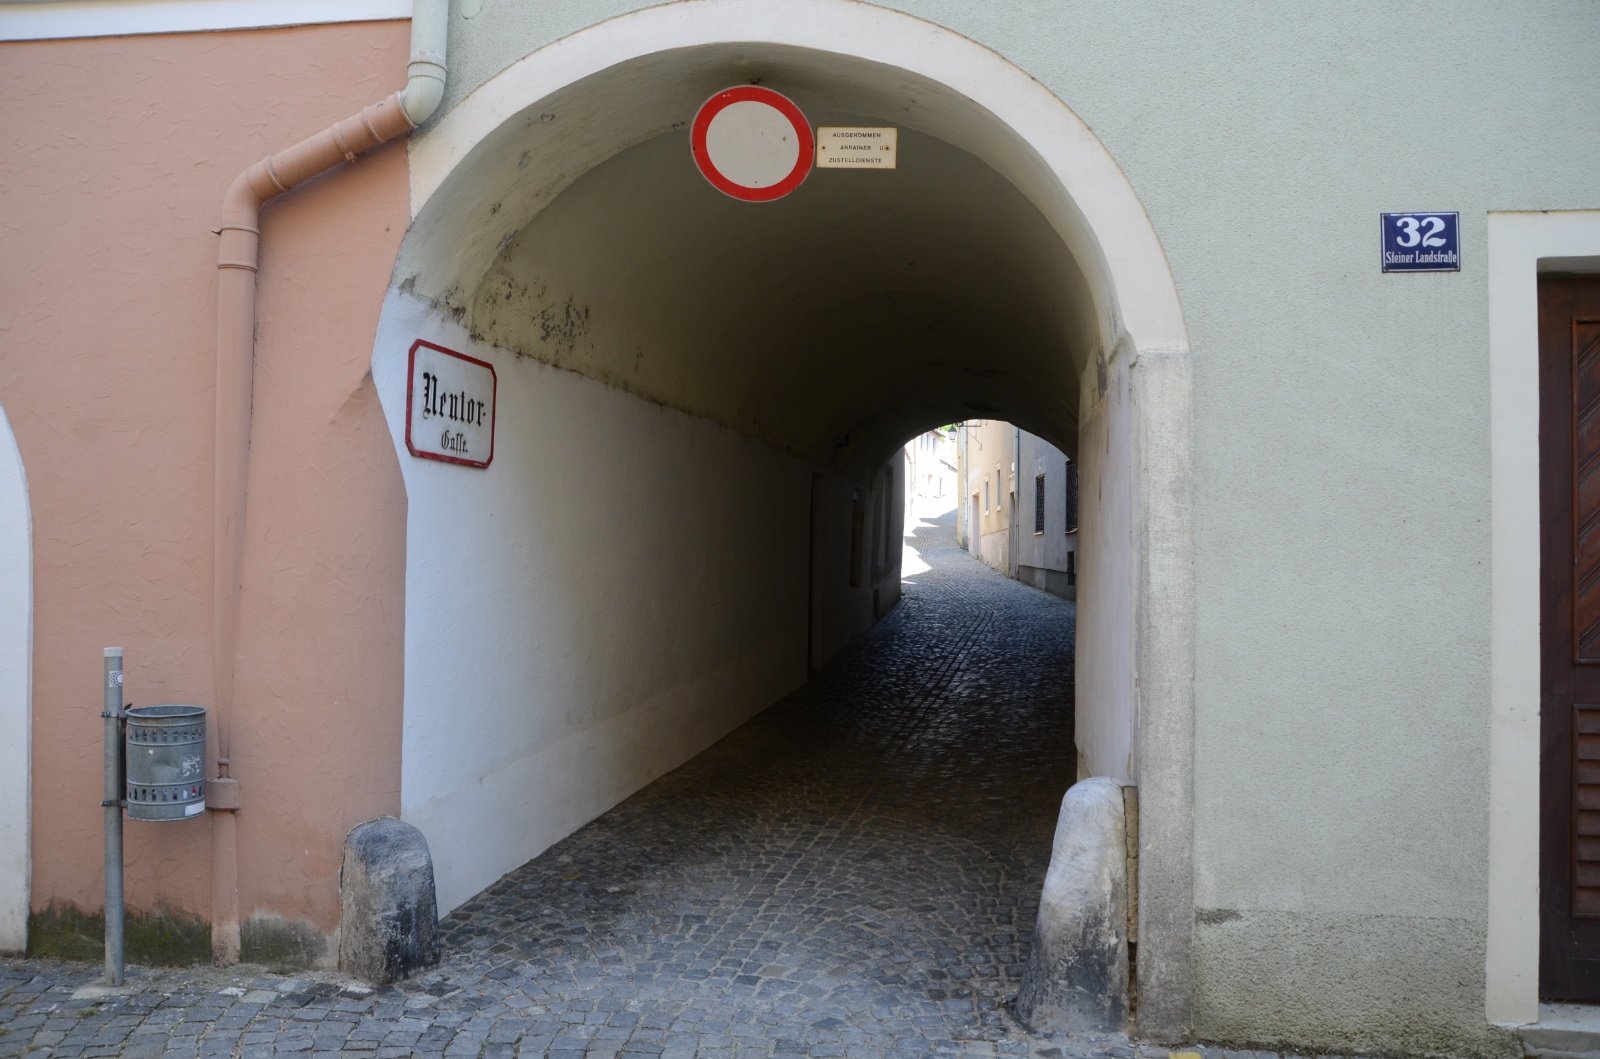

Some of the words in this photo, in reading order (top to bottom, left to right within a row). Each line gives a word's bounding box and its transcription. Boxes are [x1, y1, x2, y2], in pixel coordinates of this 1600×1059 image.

[1396, 216, 1447, 248] 32
[1385, 251, 1414, 264] Steiner
[1415, 249, 1457, 264] Landstraße
